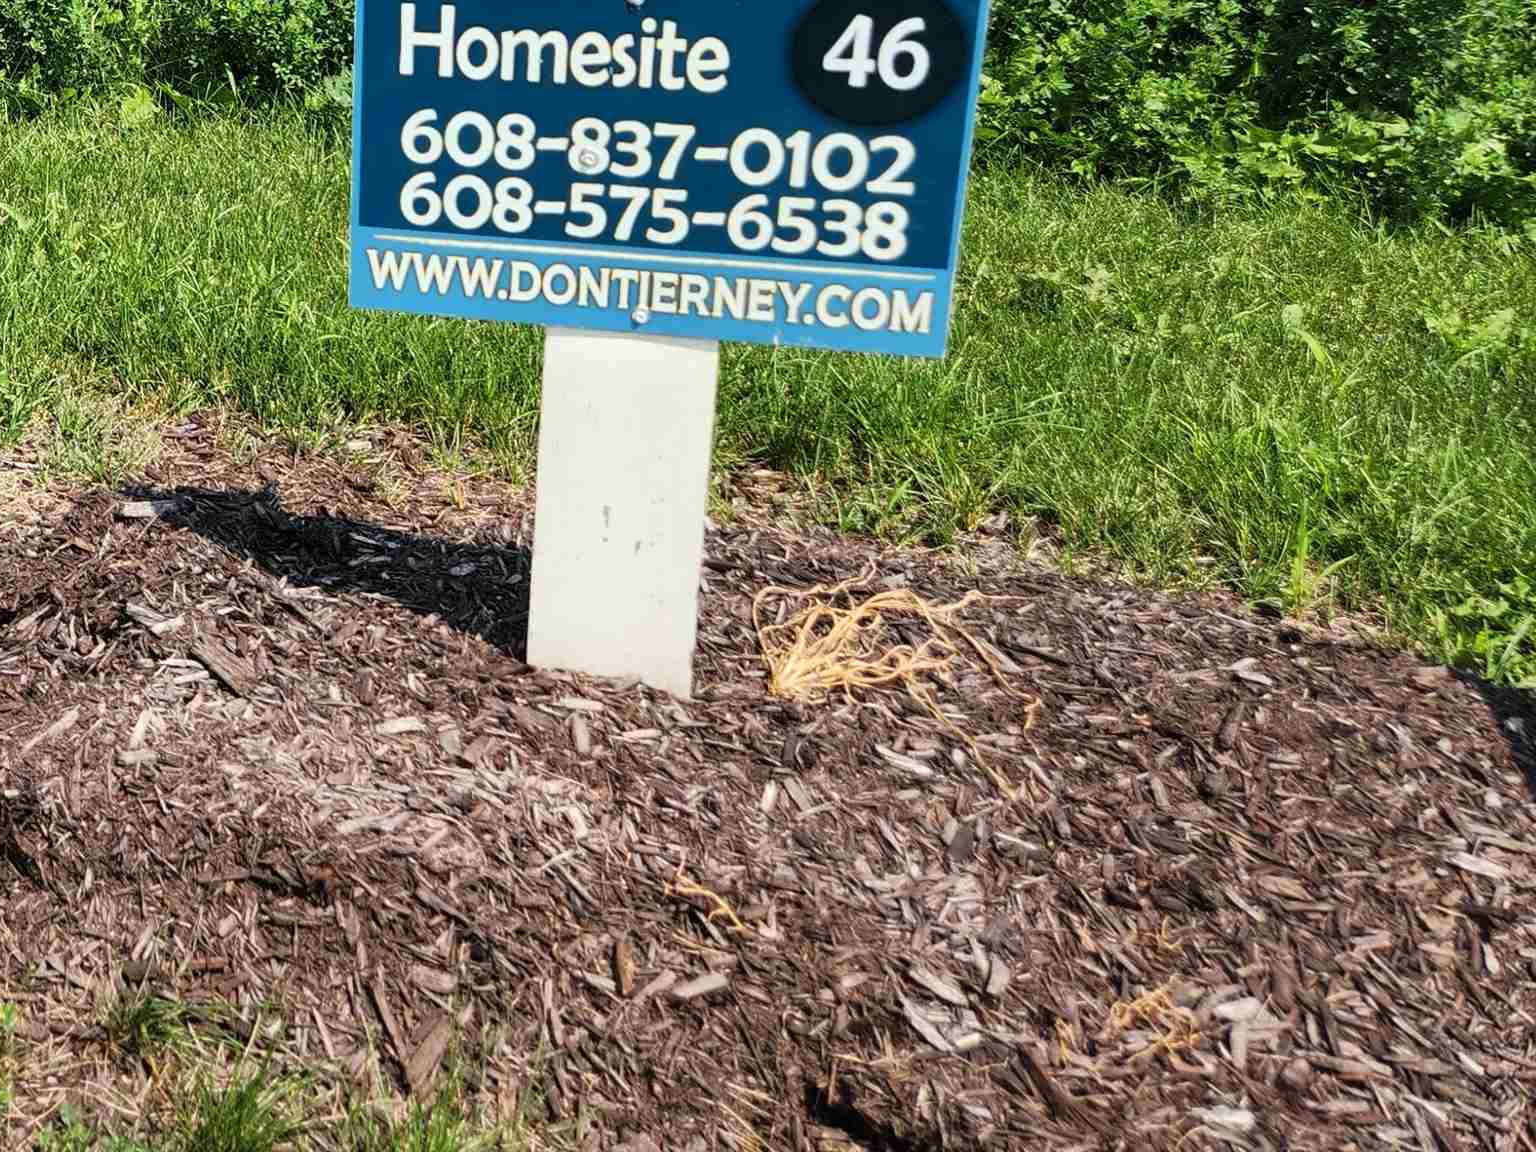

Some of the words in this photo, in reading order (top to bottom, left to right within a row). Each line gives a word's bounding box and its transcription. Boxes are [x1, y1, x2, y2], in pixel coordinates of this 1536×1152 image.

[399, 2, 730, 92] Homesite
[822, 14, 931, 91] 46
[400, 108, 916, 196] 608-837-0102
[399, 171, 909, 261] 608-575-6538
[366, 248, 934, 334] WWW.DONTIERNEY.COM
